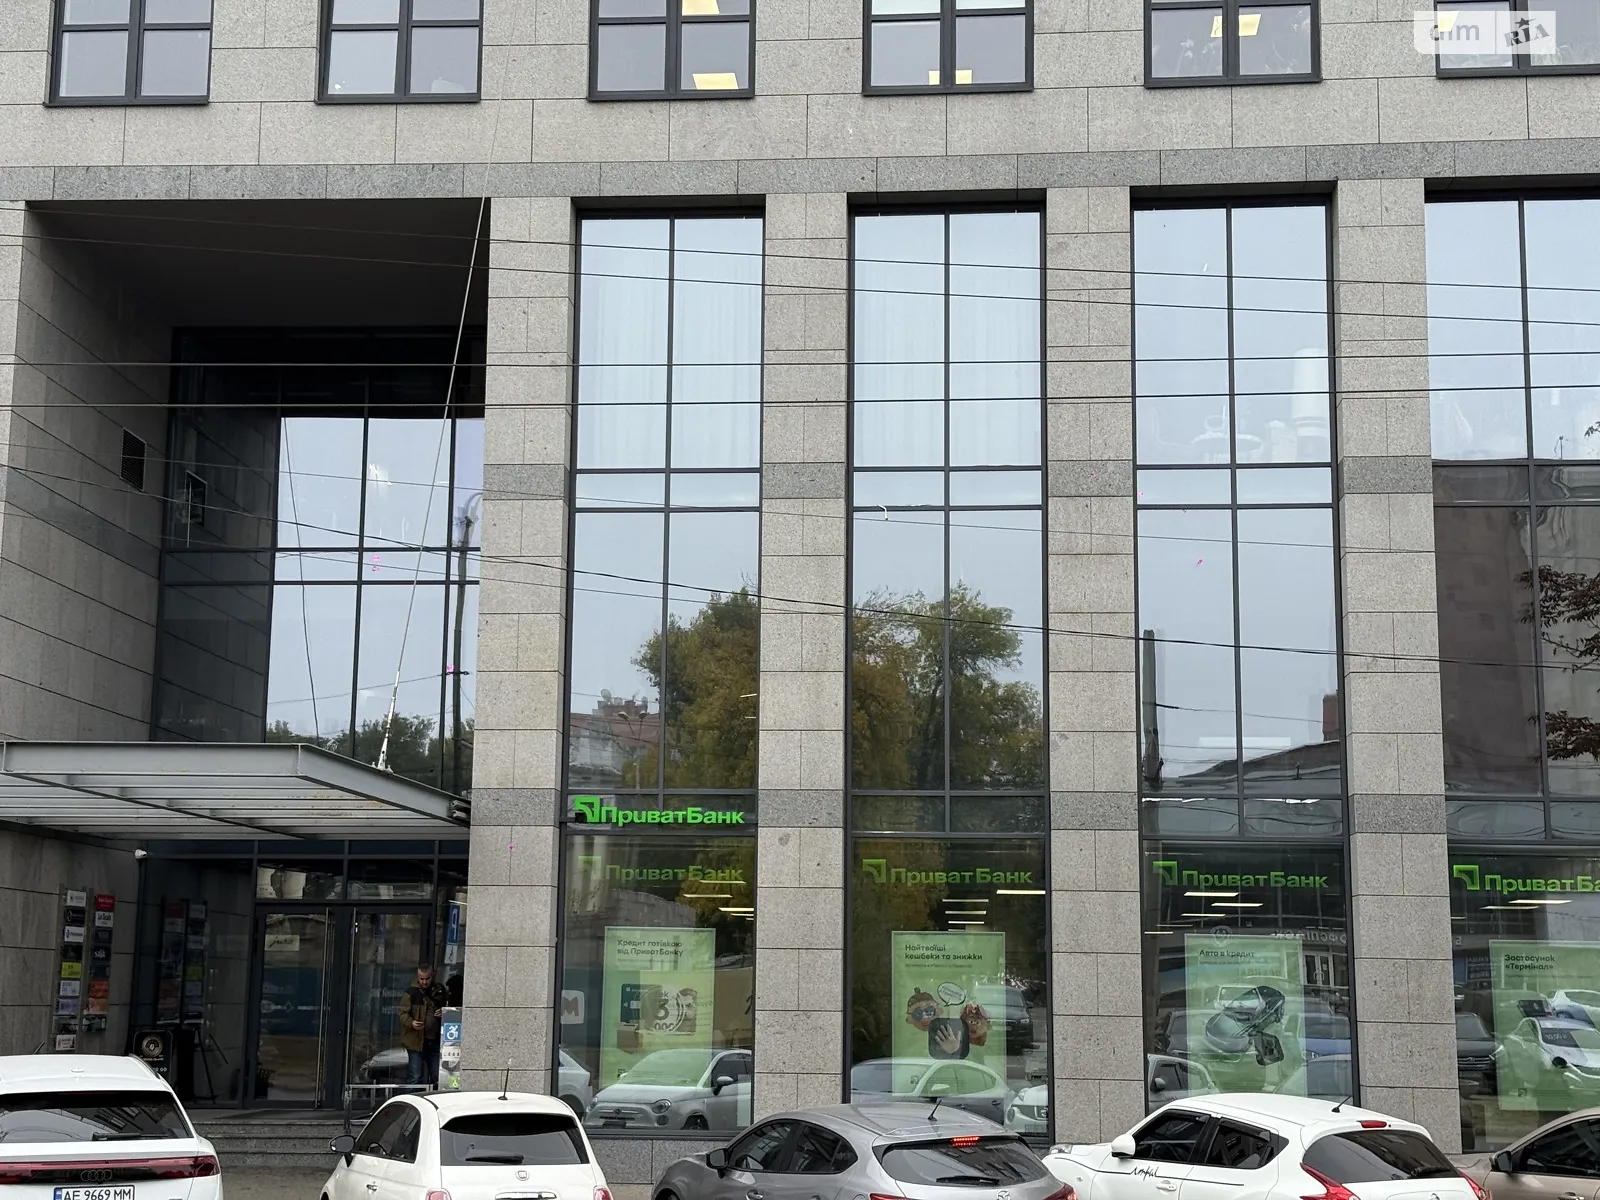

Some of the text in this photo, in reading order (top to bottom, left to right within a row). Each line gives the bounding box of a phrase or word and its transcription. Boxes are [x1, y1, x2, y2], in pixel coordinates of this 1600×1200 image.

[601, 806, 745, 827] ПриватБанк
[1199, 949, 1219, 957] Авто
[1504, 954, 1555, 963] Застосунок
[84, 1189, 110, 1200] 9669
[114, 1188, 131, 1200] MM
